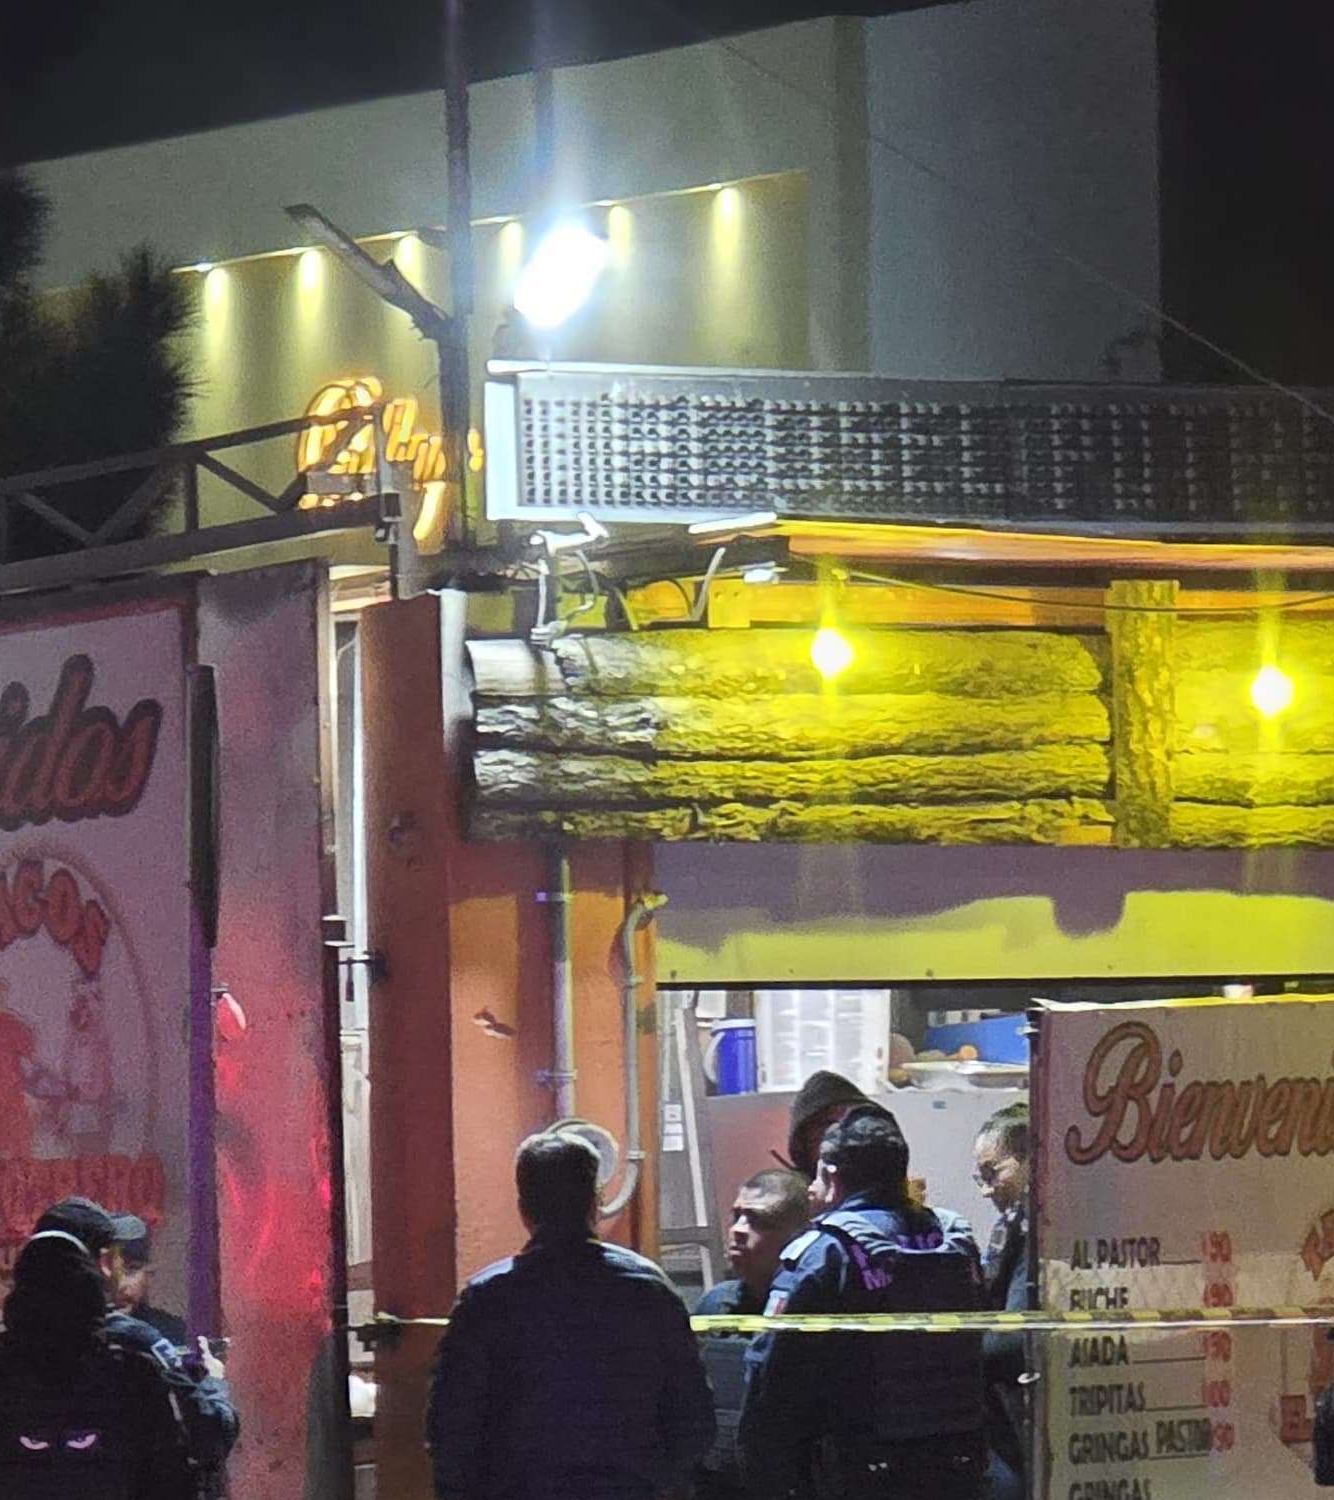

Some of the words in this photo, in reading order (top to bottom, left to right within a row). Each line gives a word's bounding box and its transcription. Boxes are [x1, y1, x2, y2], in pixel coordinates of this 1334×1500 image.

[1070, 1239, 1092, 1271] AL
[1097, 1235, 1161, 1269] PASTOR
[1069, 1334, 1129, 1368] ASADA
[1069, 1381, 1146, 1417] TRIPITAS
[1069, 1430, 1149, 1465] GRINGAS
